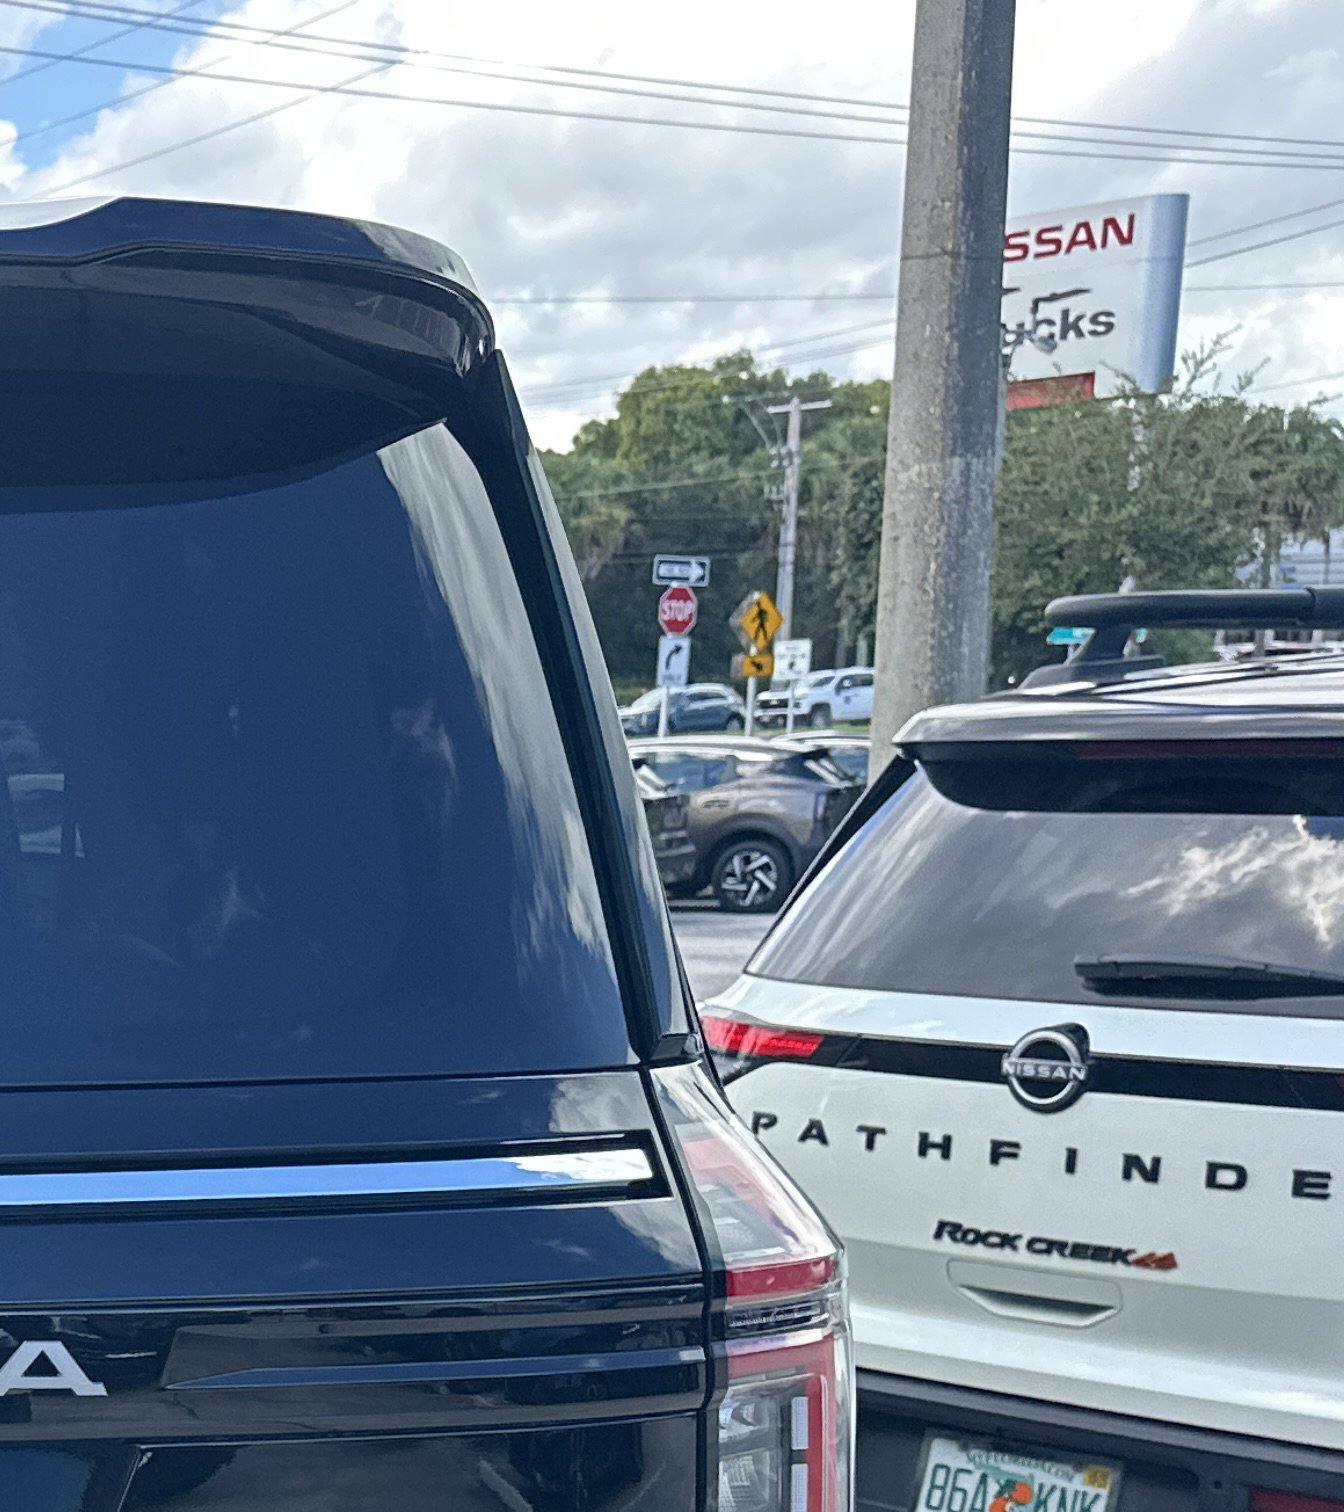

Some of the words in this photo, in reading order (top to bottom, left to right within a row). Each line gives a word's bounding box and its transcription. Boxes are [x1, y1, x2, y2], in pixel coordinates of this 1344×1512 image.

[1002, 213, 1135, 262] SSAN
[1001, 308, 1116, 349] ucks
[662, 599, 694, 621] STOP
[1002, 1057, 1088, 1082] NISSAN
[751, 1110, 1332, 1201] PATHFINDE
